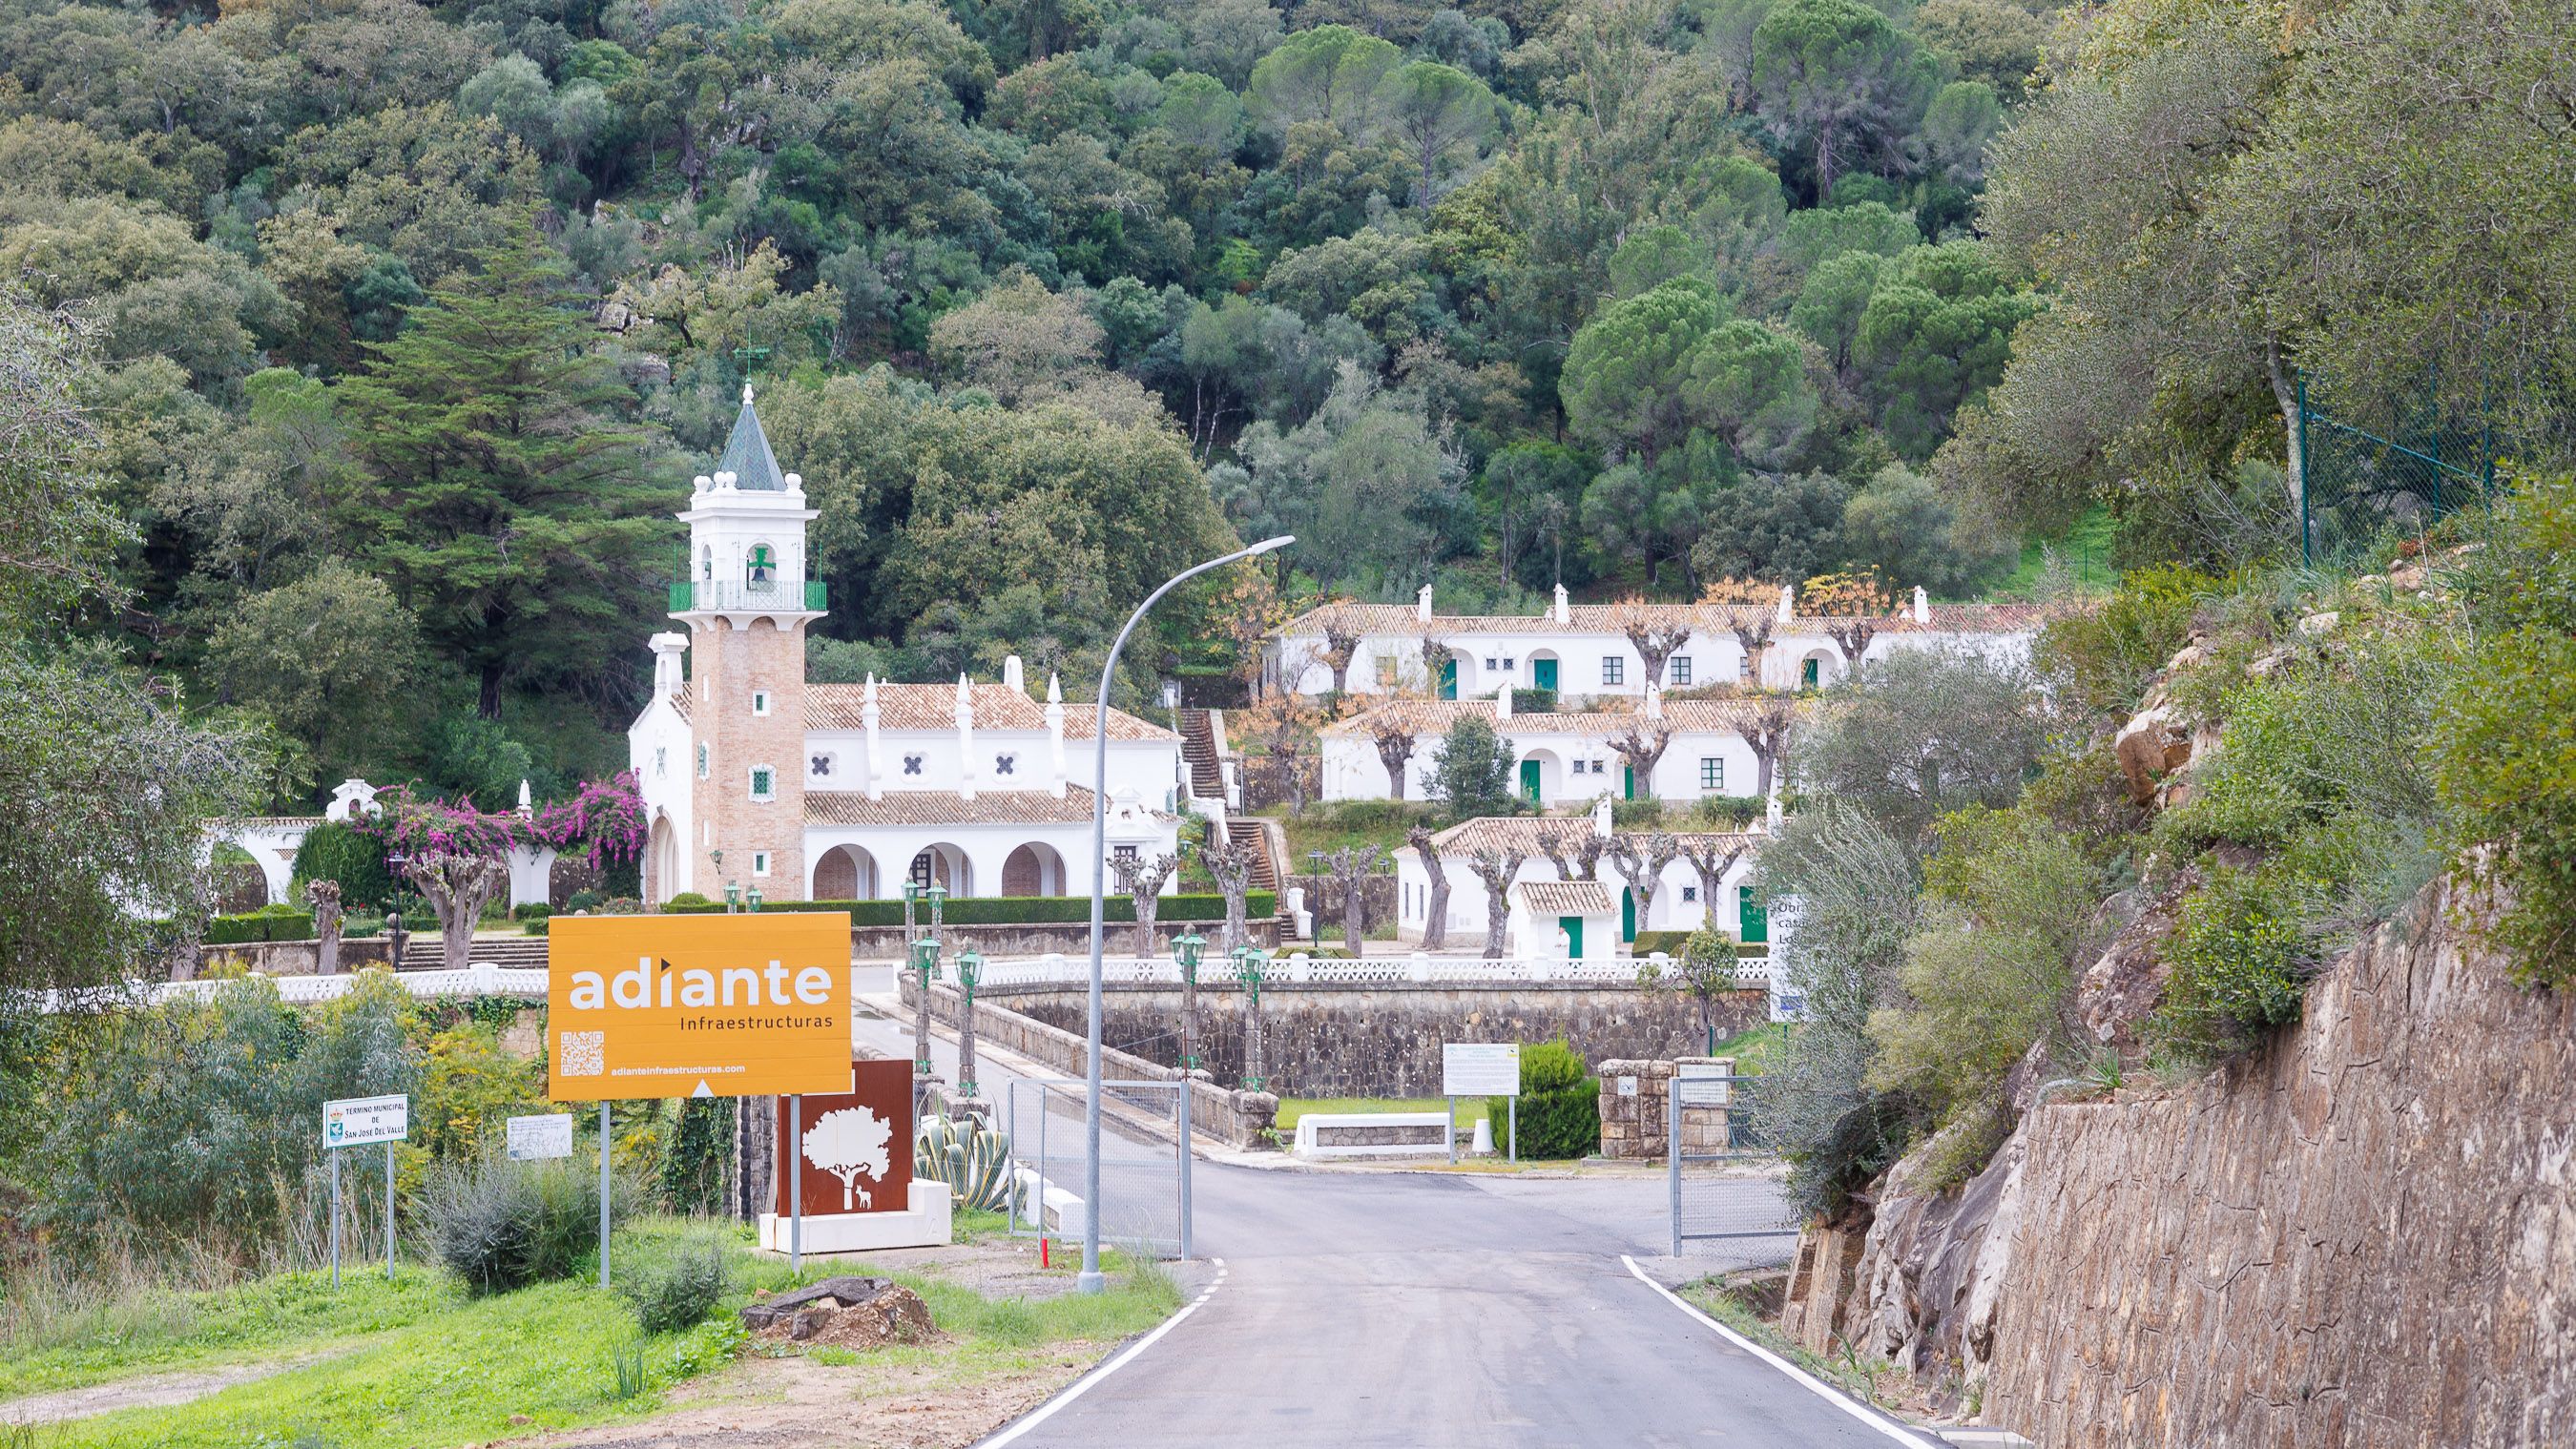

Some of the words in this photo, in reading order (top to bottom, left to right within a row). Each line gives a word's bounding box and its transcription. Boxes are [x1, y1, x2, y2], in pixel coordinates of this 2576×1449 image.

[569, 957, 832, 1009] adiante
[680, 1015, 833, 1030] Infraestructuras
[611, 1065, 746, 1076] adianteinfraestructuras.com
[373, 1103, 405, 1112] MUNICIPAL
[344, 1130, 358, 1139] SAN
[386, 1126, 405, 1134] VALLE
